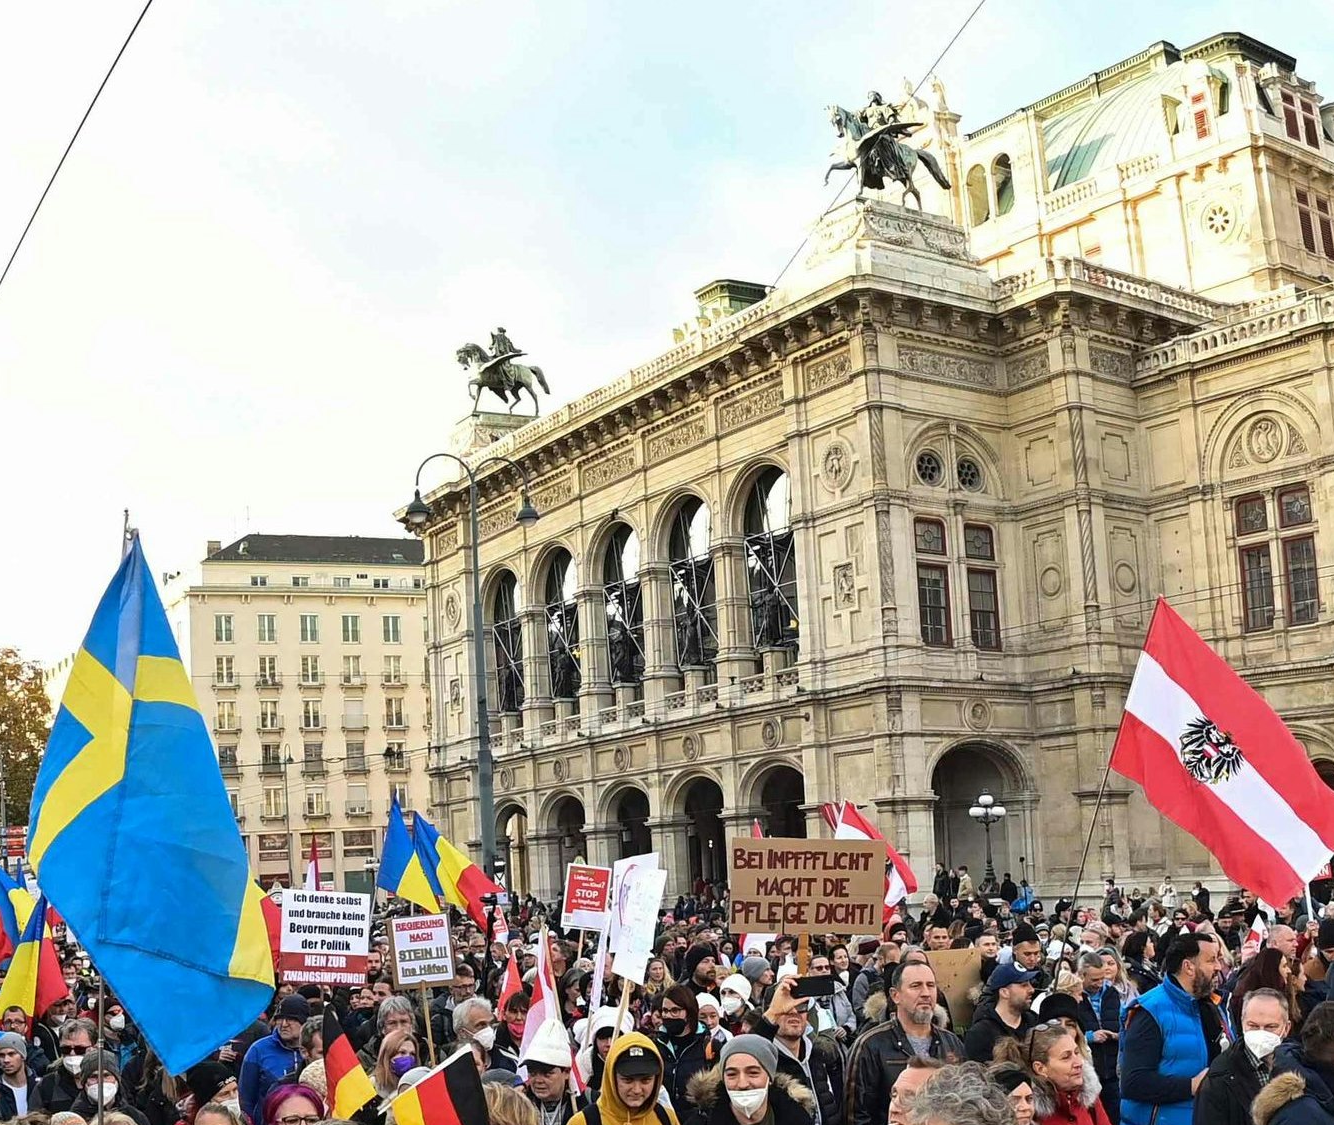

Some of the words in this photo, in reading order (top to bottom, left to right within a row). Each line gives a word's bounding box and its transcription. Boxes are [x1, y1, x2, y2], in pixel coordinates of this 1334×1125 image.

[733, 848, 763, 869] BEI
[767, 849, 873, 871] IMPFPFLICHT
[756, 876, 817, 896] MACHT
[823, 878, 850, 897] DIE
[293, 893, 307, 902] Ich
[309, 894, 334, 904] denke
[336, 896, 362, 906] selbst
[575, 889, 599, 899] STOP
[288, 909, 304, 918] und
[307, 909, 341, 919] brauche
[342, 911, 365, 921] keine
[731, 900, 809, 924] PFLEGE
[815, 903, 874, 925] DICHT!
[289, 922, 364, 938] Bevormundung
[395, 918, 444, 931] REGIERUNG
[409, 932, 433, 941] NACH
[301, 939, 318, 949] der
[320, 940, 351, 951] Politik
[399, 947, 432, 960] STEIN
[304, 954, 326, 967] NEIN
[327, 956, 346, 968] ZUR
